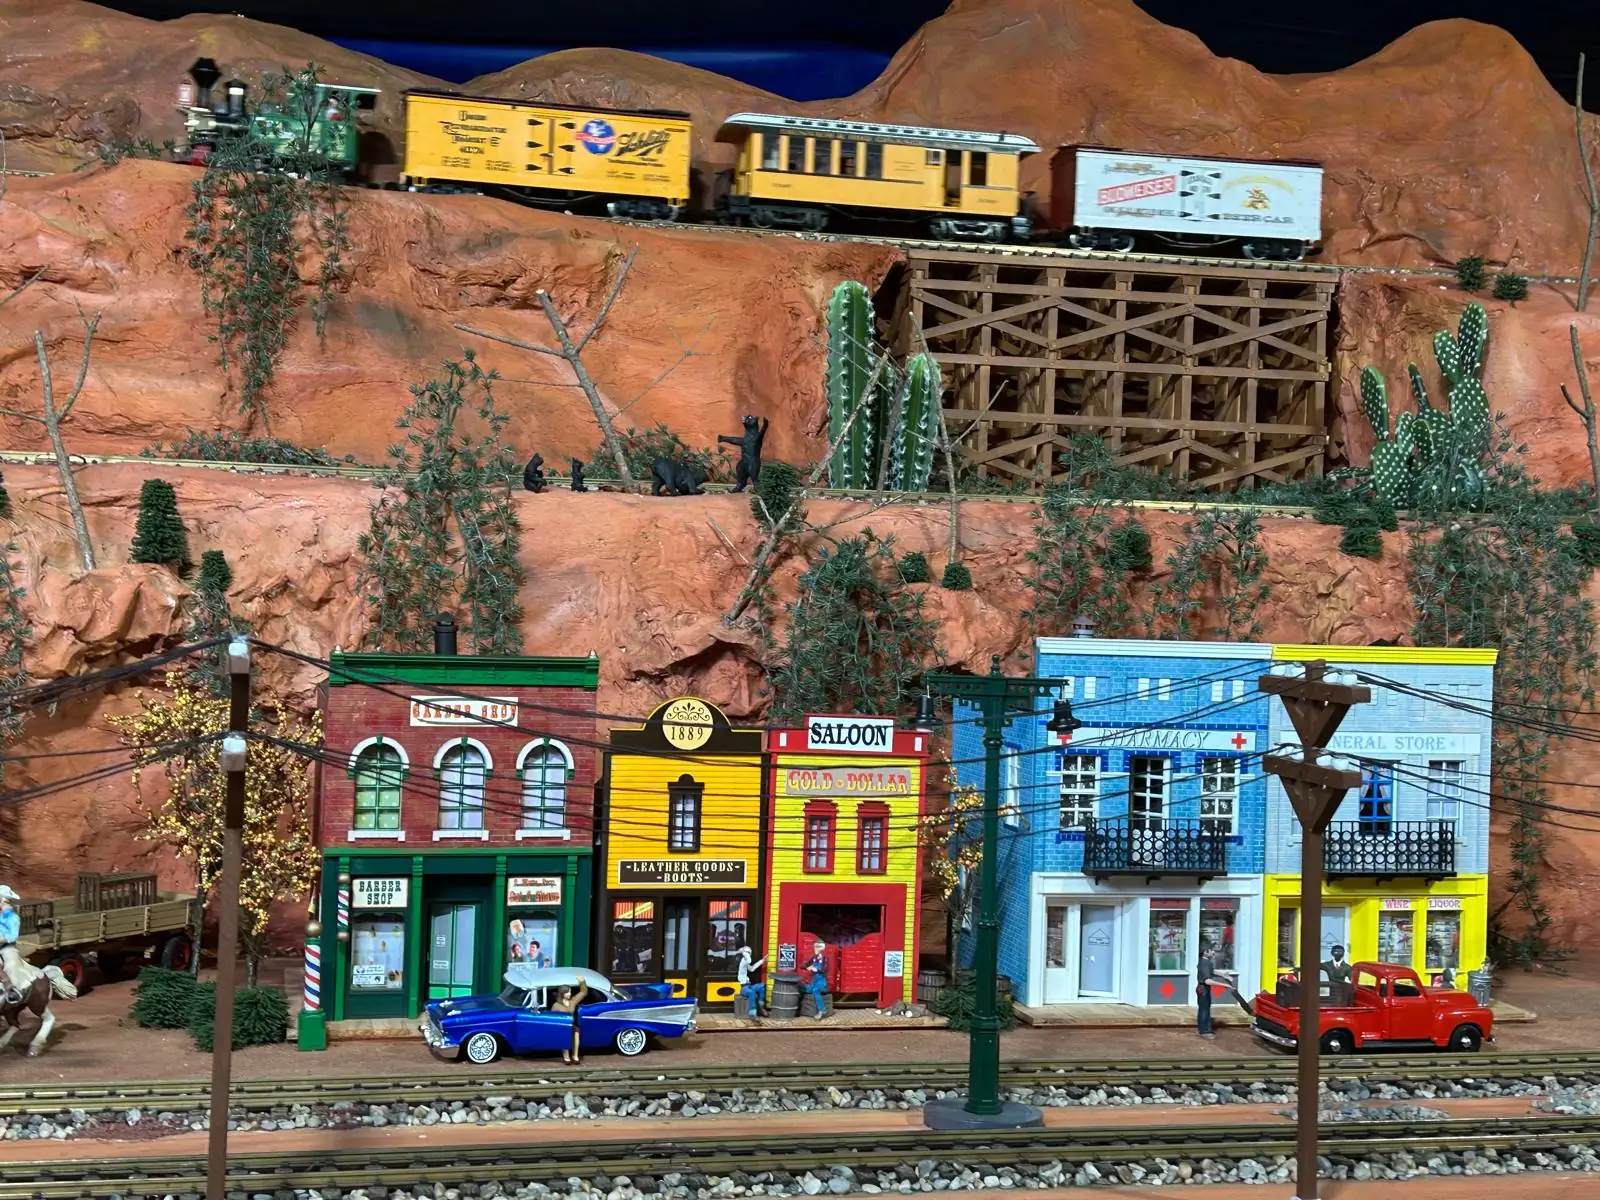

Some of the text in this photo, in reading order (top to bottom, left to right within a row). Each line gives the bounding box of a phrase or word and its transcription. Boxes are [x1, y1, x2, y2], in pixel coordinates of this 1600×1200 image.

[671, 726, 703, 740] 1889
[811, 722, 889, 746] SALOON
[1101, 728, 1211, 749] PHARMACY
[1332, 735, 1447, 751] NERAL STORE
[788, 769, 908, 795] GOLD DOLLAR
[359, 881, 402, 892] BARBER
[367, 893, 393, 905] SHOP
[1429, 899, 1460, 909] LIQUOR
